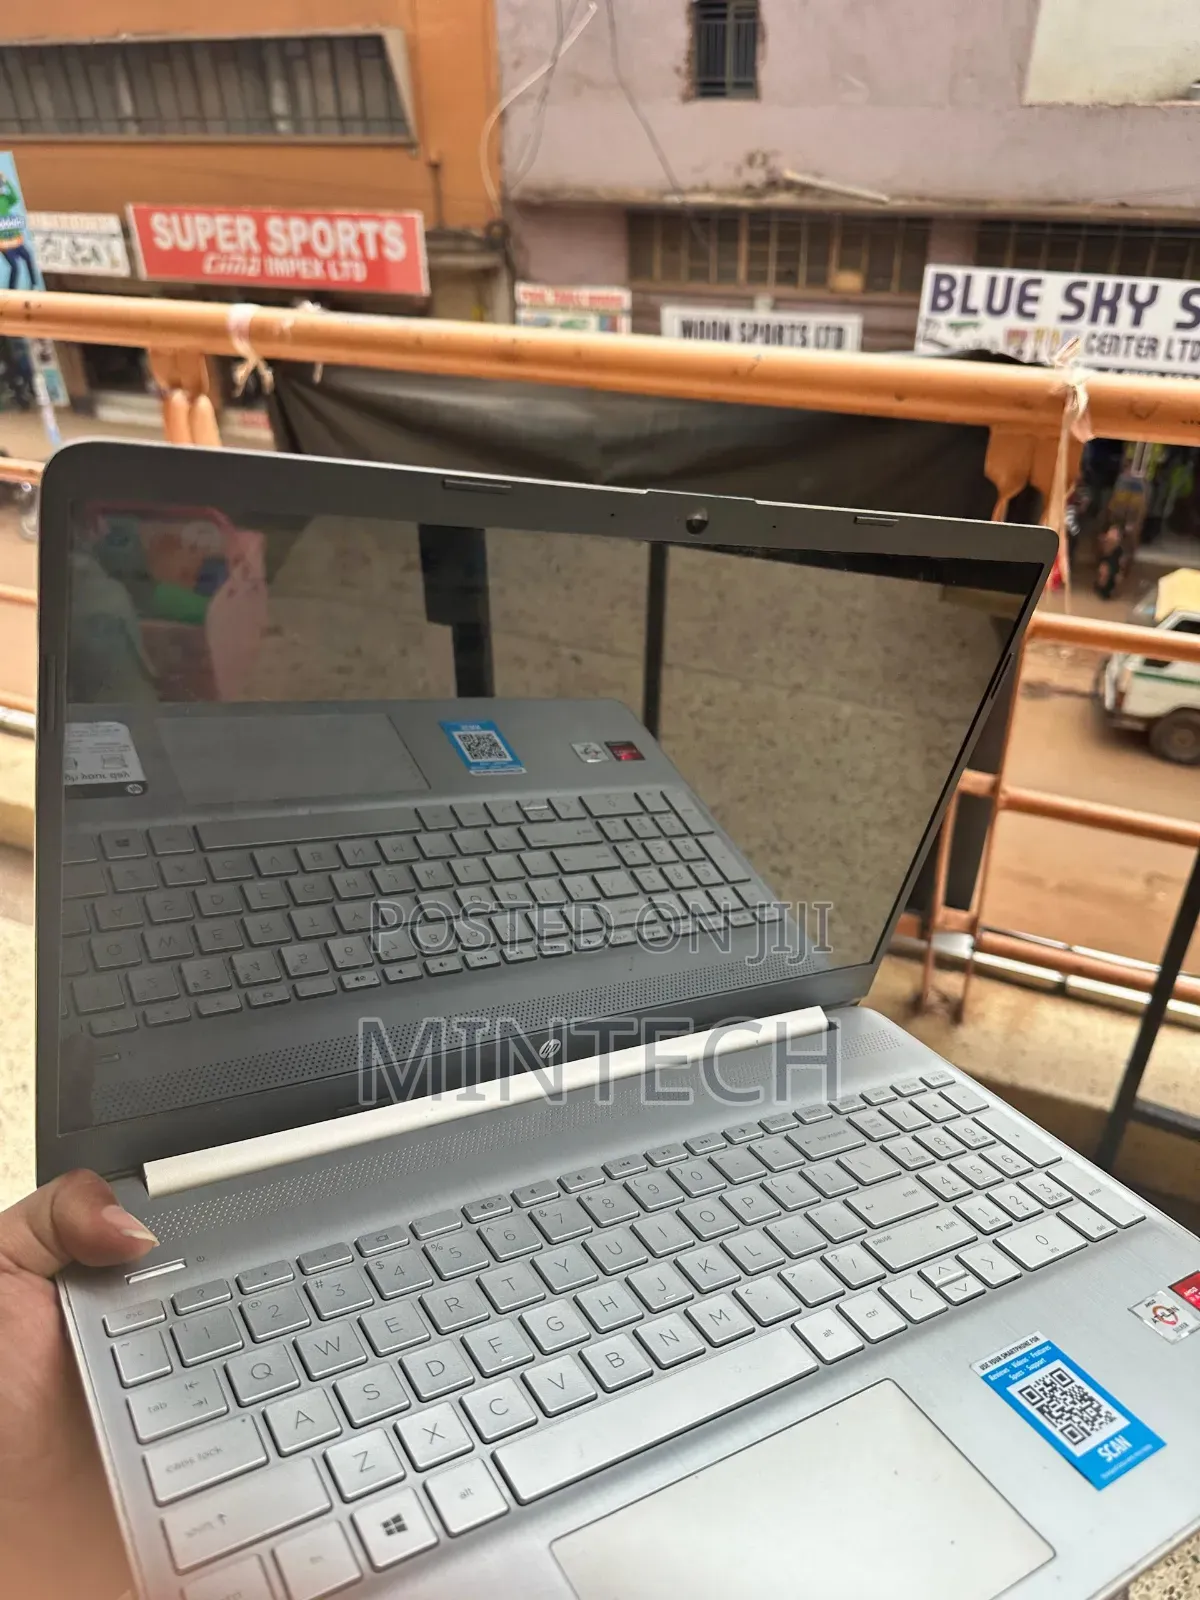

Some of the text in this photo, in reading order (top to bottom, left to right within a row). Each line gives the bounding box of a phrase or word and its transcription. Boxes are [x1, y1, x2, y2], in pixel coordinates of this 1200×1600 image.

[149, 211, 259, 253] SUPER
[265, 216, 407, 262] SPORTS
[328, 261, 367, 283] LTD
[930, 273, 1042, 318] BLUE
[1060, 281, 1159, 327] SKY
[739, 322, 807, 348] SPORTS
[1085, 332, 1159, 360] CENTER
[539, 1039, 561, 1059] hp
[964, 1127, 976, 1136] 9
[933, 1137, 946, 1146] 8
[902, 1147, 912, 1156] 7
[1001, 1153, 1014, 1163] 6
[690, 1171, 703, 1181] 0
[970, 1165, 983, 1175] 5
[940, 1176, 951, 1185] 4
[648, 1184, 660, 1194] 9
[903, 1188, 919, 1198] enter
[1039, 1183, 1052, 1193] 3
[602, 1198, 615, 1208] 8
[742, 1196, 754, 1209] P
[1009, 1195, 1023, 1205] 2
[554, 1213, 563, 1224] 7
[700, 1210, 716, 1223] O
[978, 1207, 990, 1217] 1
[943, 1220, 958, 1230] shift
[988, 1216, 1001, 1225] end
[504, 1229, 516, 1241] 6
[872, 1234, 893, 1246] pause
[1035, 1234, 1049, 1245] 0
[430, 1243, 443, 1252] %
[449, 1246, 462, 1259] 5
[605, 1241, 623, 1255] U
[744, 1245, 761, 1257] L
[376, 1261, 385, 1270] $
[394, 1265, 405, 1276] 4
[554, 1258, 569, 1273] Y
[697, 1259, 717, 1274] K
[315, 1279, 323, 1289] #
[501, 1276, 516, 1291] T
[656, 1277, 668, 1292] J
[332, 1284, 346, 1297] 3
[268, 1304, 283, 1318] 2
[444, 1297, 464, 1313] R
[599, 1296, 619, 1313] H
[125, 1310, 145, 1320] esc
[708, 1309, 731, 1326] M
[866, 1309, 879, 1318] ctrl
[384, 1316, 403, 1334] E
[546, 1316, 565, 1332] G
[204, 1326, 211, 1339] 1
[659, 1330, 681, 1346] N
[822, 1328, 834, 1338] alt
[314, 1336, 341, 1356] W
[487, 1336, 503, 1353] F
[979, 1335, 1041, 1371] USE YOUR SMARTPHONE FOR
[605, 1352, 625, 1368] B
[251, 1362, 273, 1379] Q
[425, 1359, 446, 1378] D
[547, 1373, 565, 1390] V
[363, 1383, 381, 1401] S
[148, 1401, 168, 1413] tab
[489, 1398, 509, 1416] C
[295, 1410, 315, 1429] A
[422, 1422, 447, 1445] X
[1097, 1434, 1133, 1463] SCAN
[352, 1450, 376, 1473] Z
[459, 1486, 474, 1500] alt
